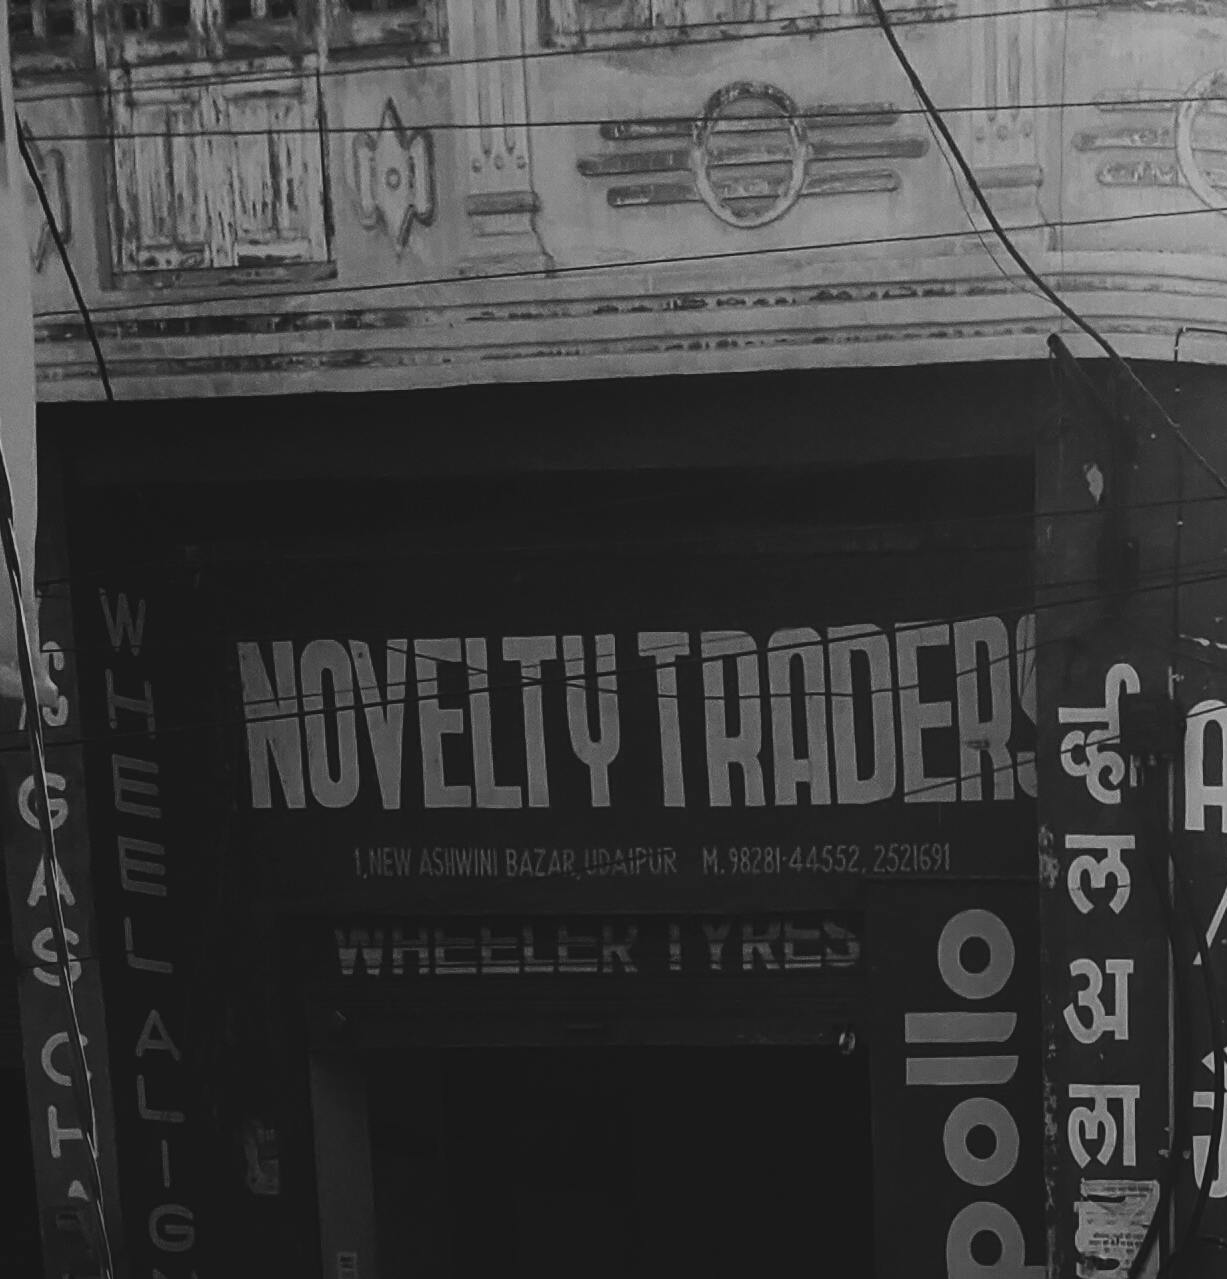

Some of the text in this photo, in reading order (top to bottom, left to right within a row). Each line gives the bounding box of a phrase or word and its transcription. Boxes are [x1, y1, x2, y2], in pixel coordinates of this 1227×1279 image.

[98, 586, 174, 974] WHEEL
[236, 634, 620, 811] NOVELTY
[17, 771, 83, 987] GAS
